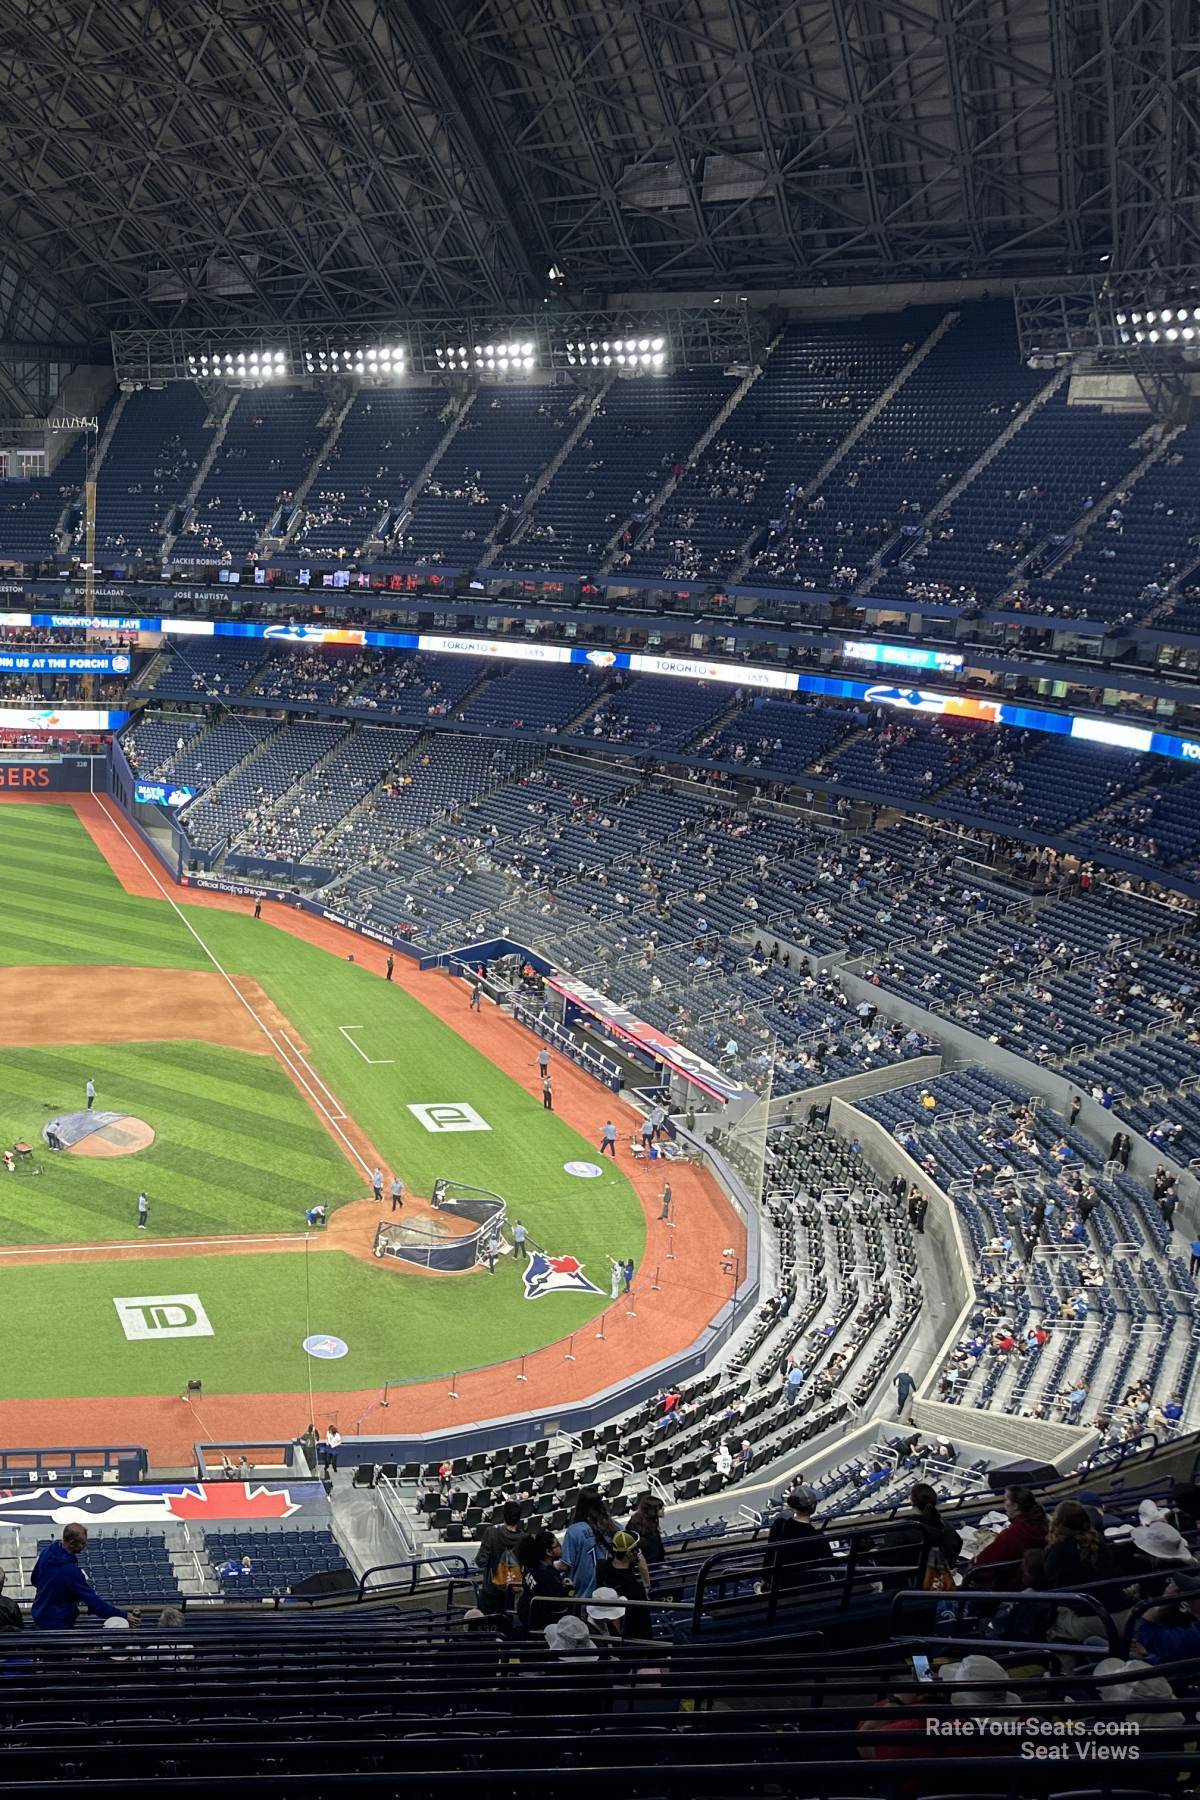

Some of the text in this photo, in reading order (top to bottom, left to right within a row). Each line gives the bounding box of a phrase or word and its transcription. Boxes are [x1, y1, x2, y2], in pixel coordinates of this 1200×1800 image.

[196, 558, 232, 566] ROBINSON
[91, 588, 124, 596] HALLADAY
[194, 592, 229, 600] BAUTISTA
[51, 617, 91, 627] TORONTO
[121, 619, 140, 629] JAYS
[443, 640, 488, 652] TORONTO
[16, 656, 29, 667] US
[32, 657, 45, 668] AT
[48, 658, 66, 668] THE
[69, 658, 108, 669] PORCH!
[656, 661, 707, 675] TORONTO
[125, 1302, 197, 1329] TD
